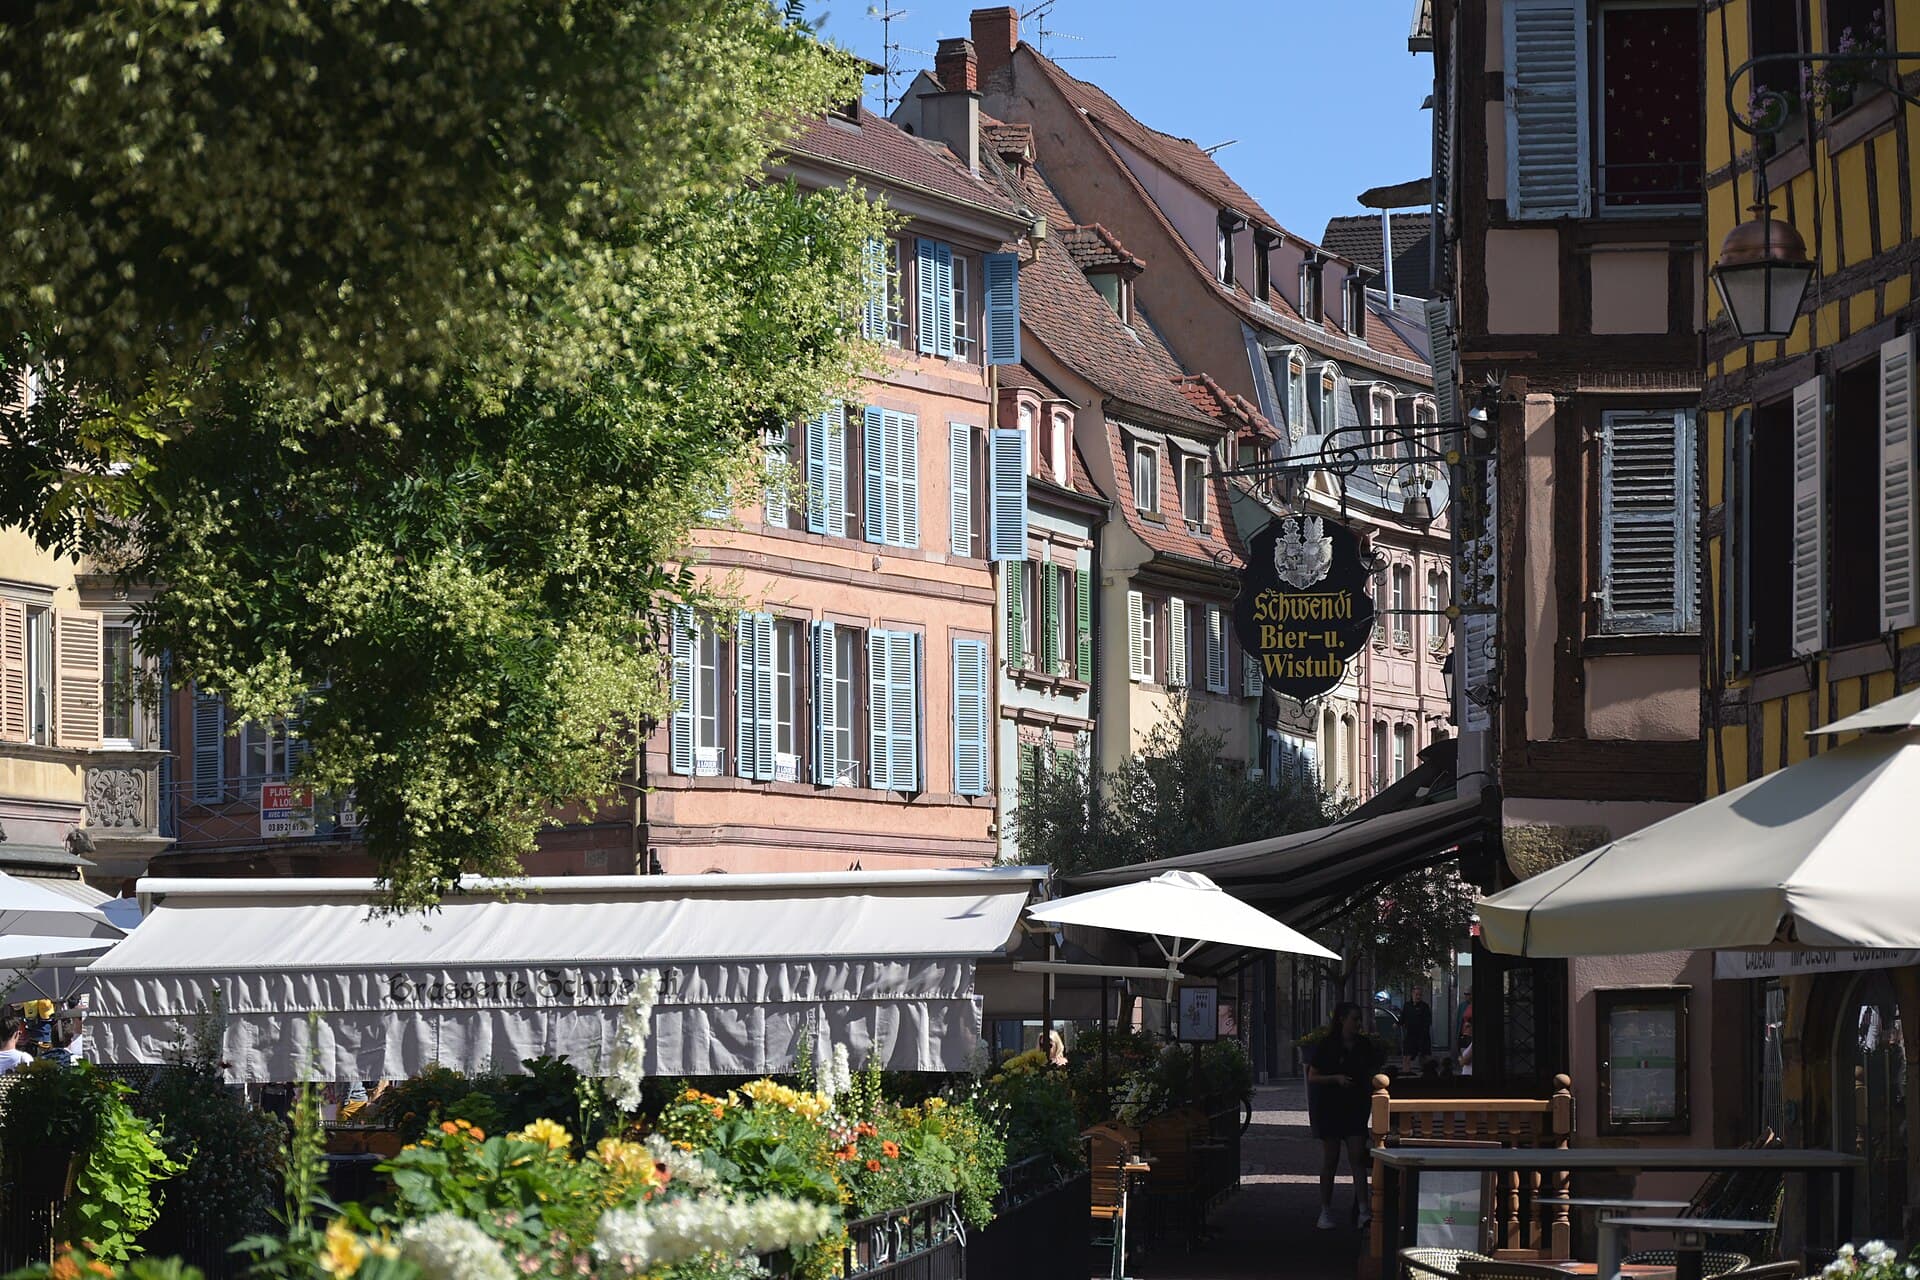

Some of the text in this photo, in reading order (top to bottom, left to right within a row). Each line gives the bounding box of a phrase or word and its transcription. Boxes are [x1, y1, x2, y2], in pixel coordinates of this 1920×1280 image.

[1253, 588, 1352, 623] Schwendi
[1263, 653, 1343, 679] Wistub
[382, 968, 678, 1004] Brasserie Schwedi
